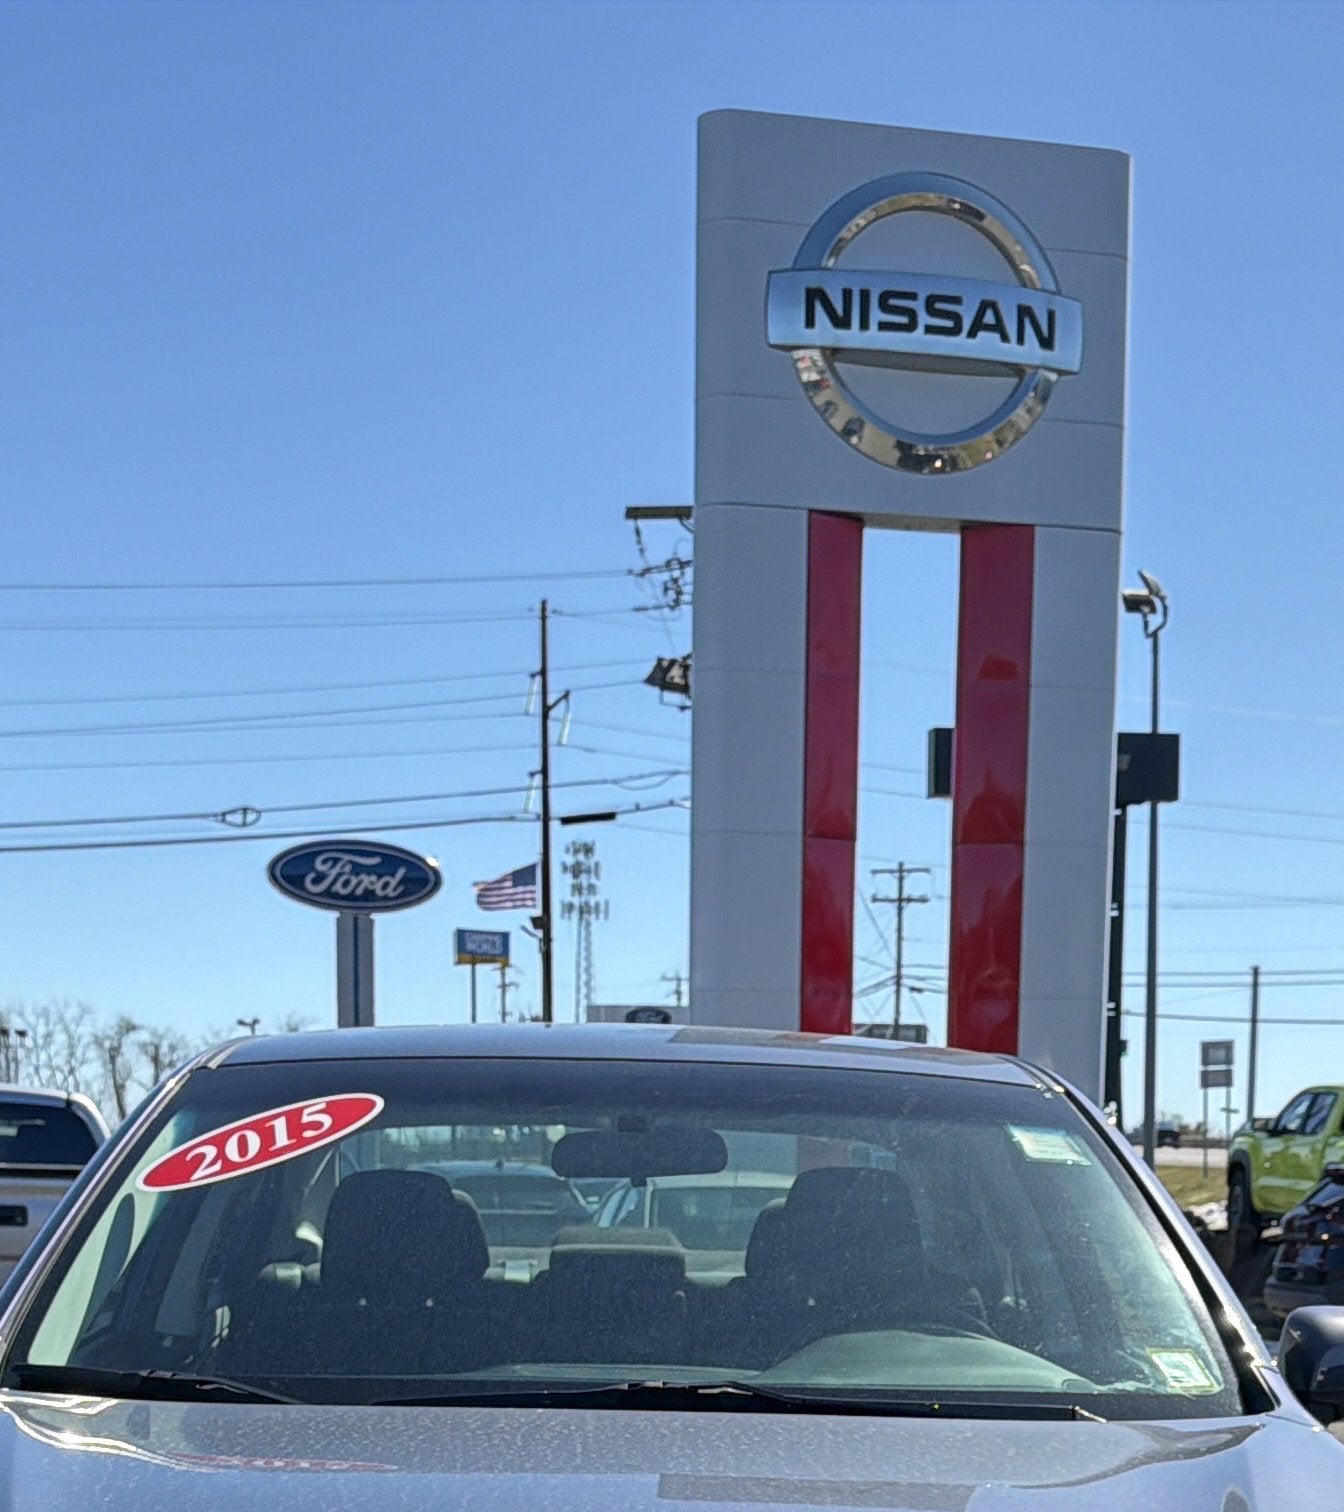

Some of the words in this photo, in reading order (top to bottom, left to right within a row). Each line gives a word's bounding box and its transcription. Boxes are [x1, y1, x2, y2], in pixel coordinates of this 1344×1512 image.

[804, 285, 1056, 352] NISSAN
[306, 851, 406, 898] Ford
[185, 1101, 333, 1182] 2015
